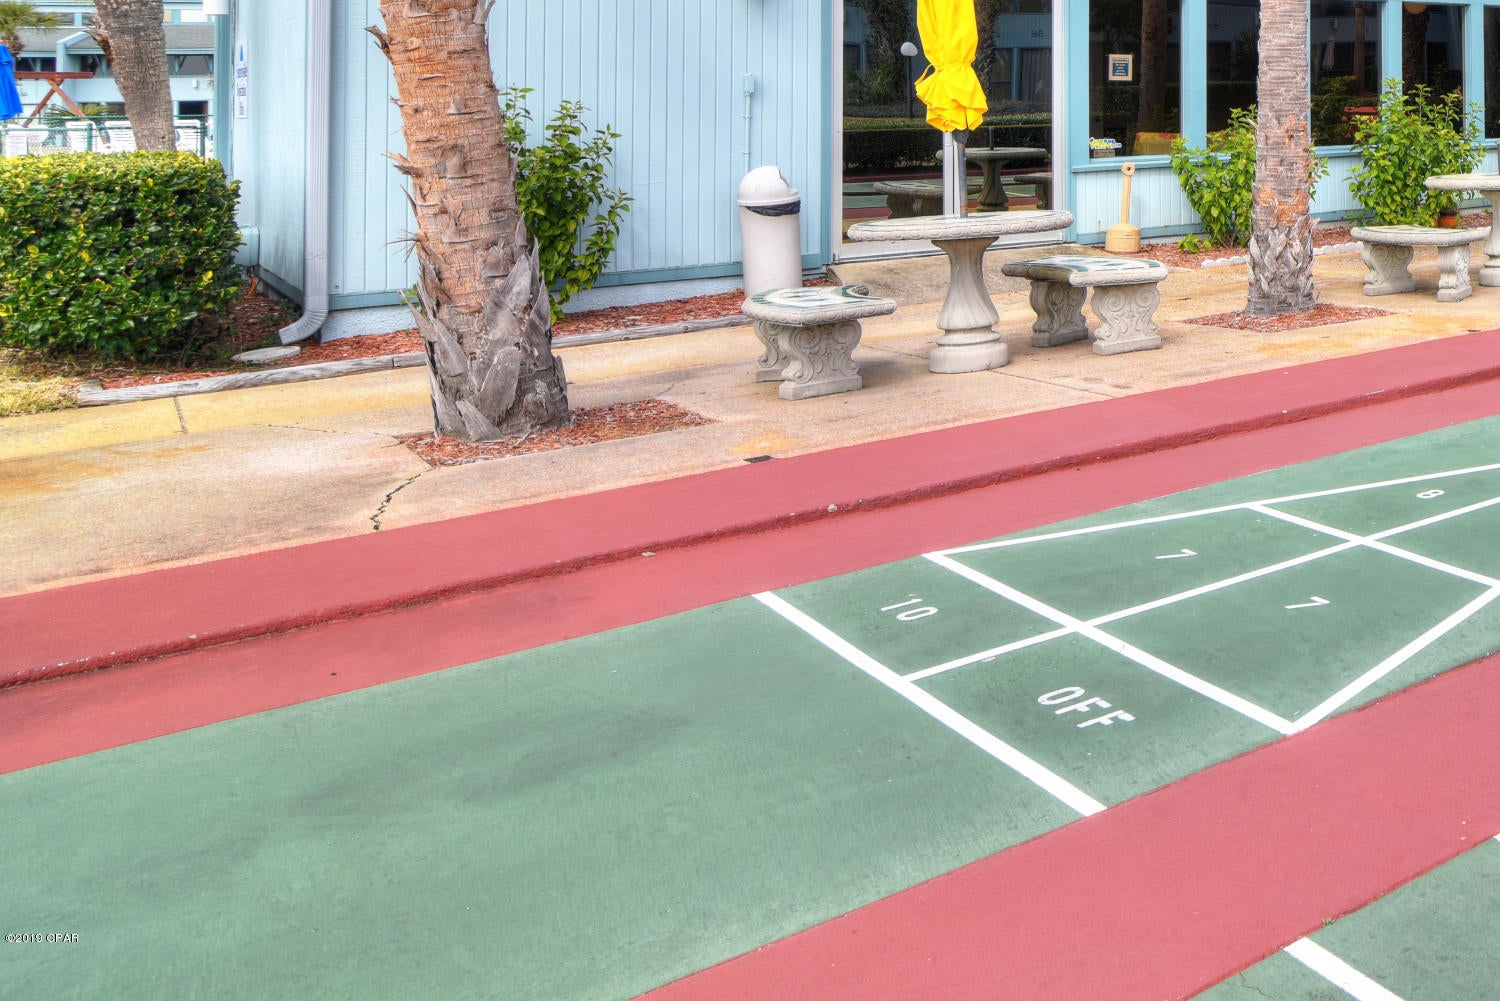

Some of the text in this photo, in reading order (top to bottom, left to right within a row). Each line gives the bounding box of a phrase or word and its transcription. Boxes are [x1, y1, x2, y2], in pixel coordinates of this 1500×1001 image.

[1416, 489, 1445, 500] 8
[1155, 548, 1198, 561] 7
[880, 596, 939, 622] 10
[1284, 595, 1330, 611] 7
[1036, 685, 1136, 729] OFF
